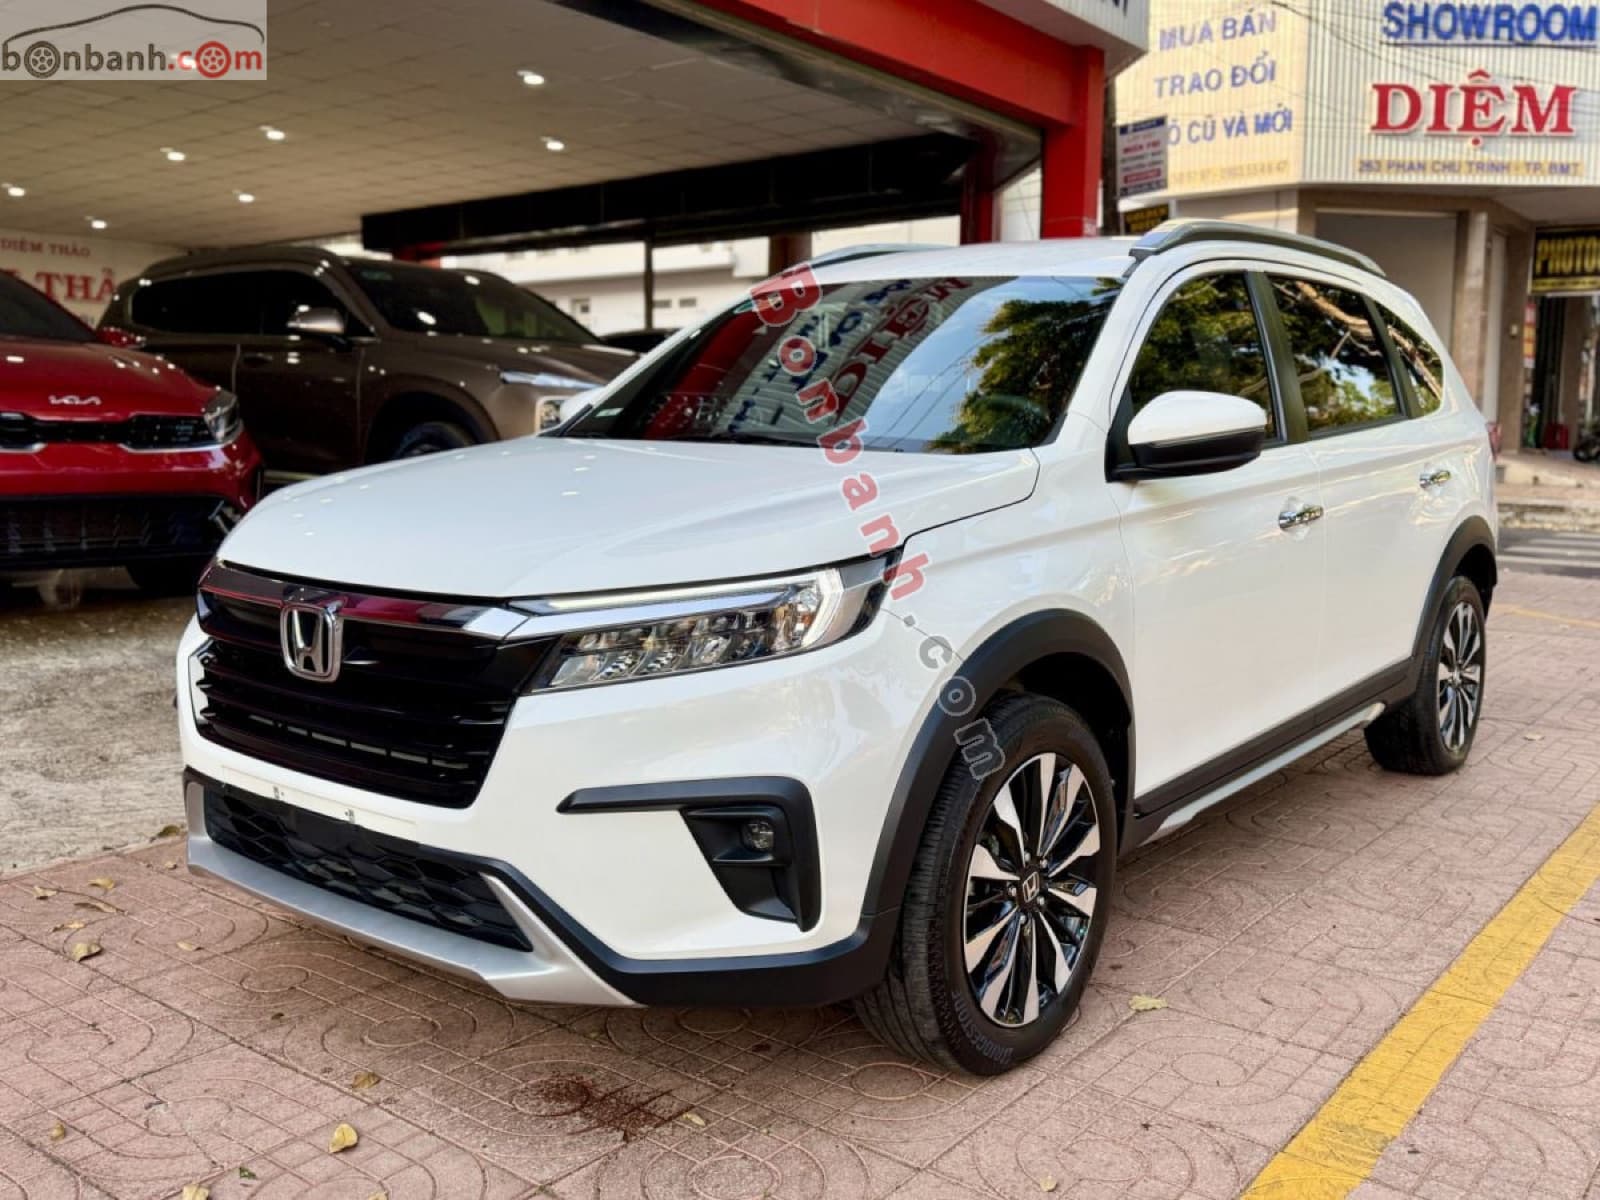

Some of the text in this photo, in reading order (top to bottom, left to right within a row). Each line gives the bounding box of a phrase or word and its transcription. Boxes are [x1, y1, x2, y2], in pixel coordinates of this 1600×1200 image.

[1159, 7, 1276, 51] MUA BÁN
[1382, 1, 1598, 41] SHOWROOM
[1154, 50, 1276, 98] TRAO ĐỔI
[1187, 113, 1216, 144] CŨ
[1223, 111, 1249, 138] VÀ
[1369, 68, 1578, 148] DIỆM
[1386, 160, 1427, 173] PHAN
[1467, 161, 1509, 175] TRINH
[1547, 162, 1580, 175] BMT
